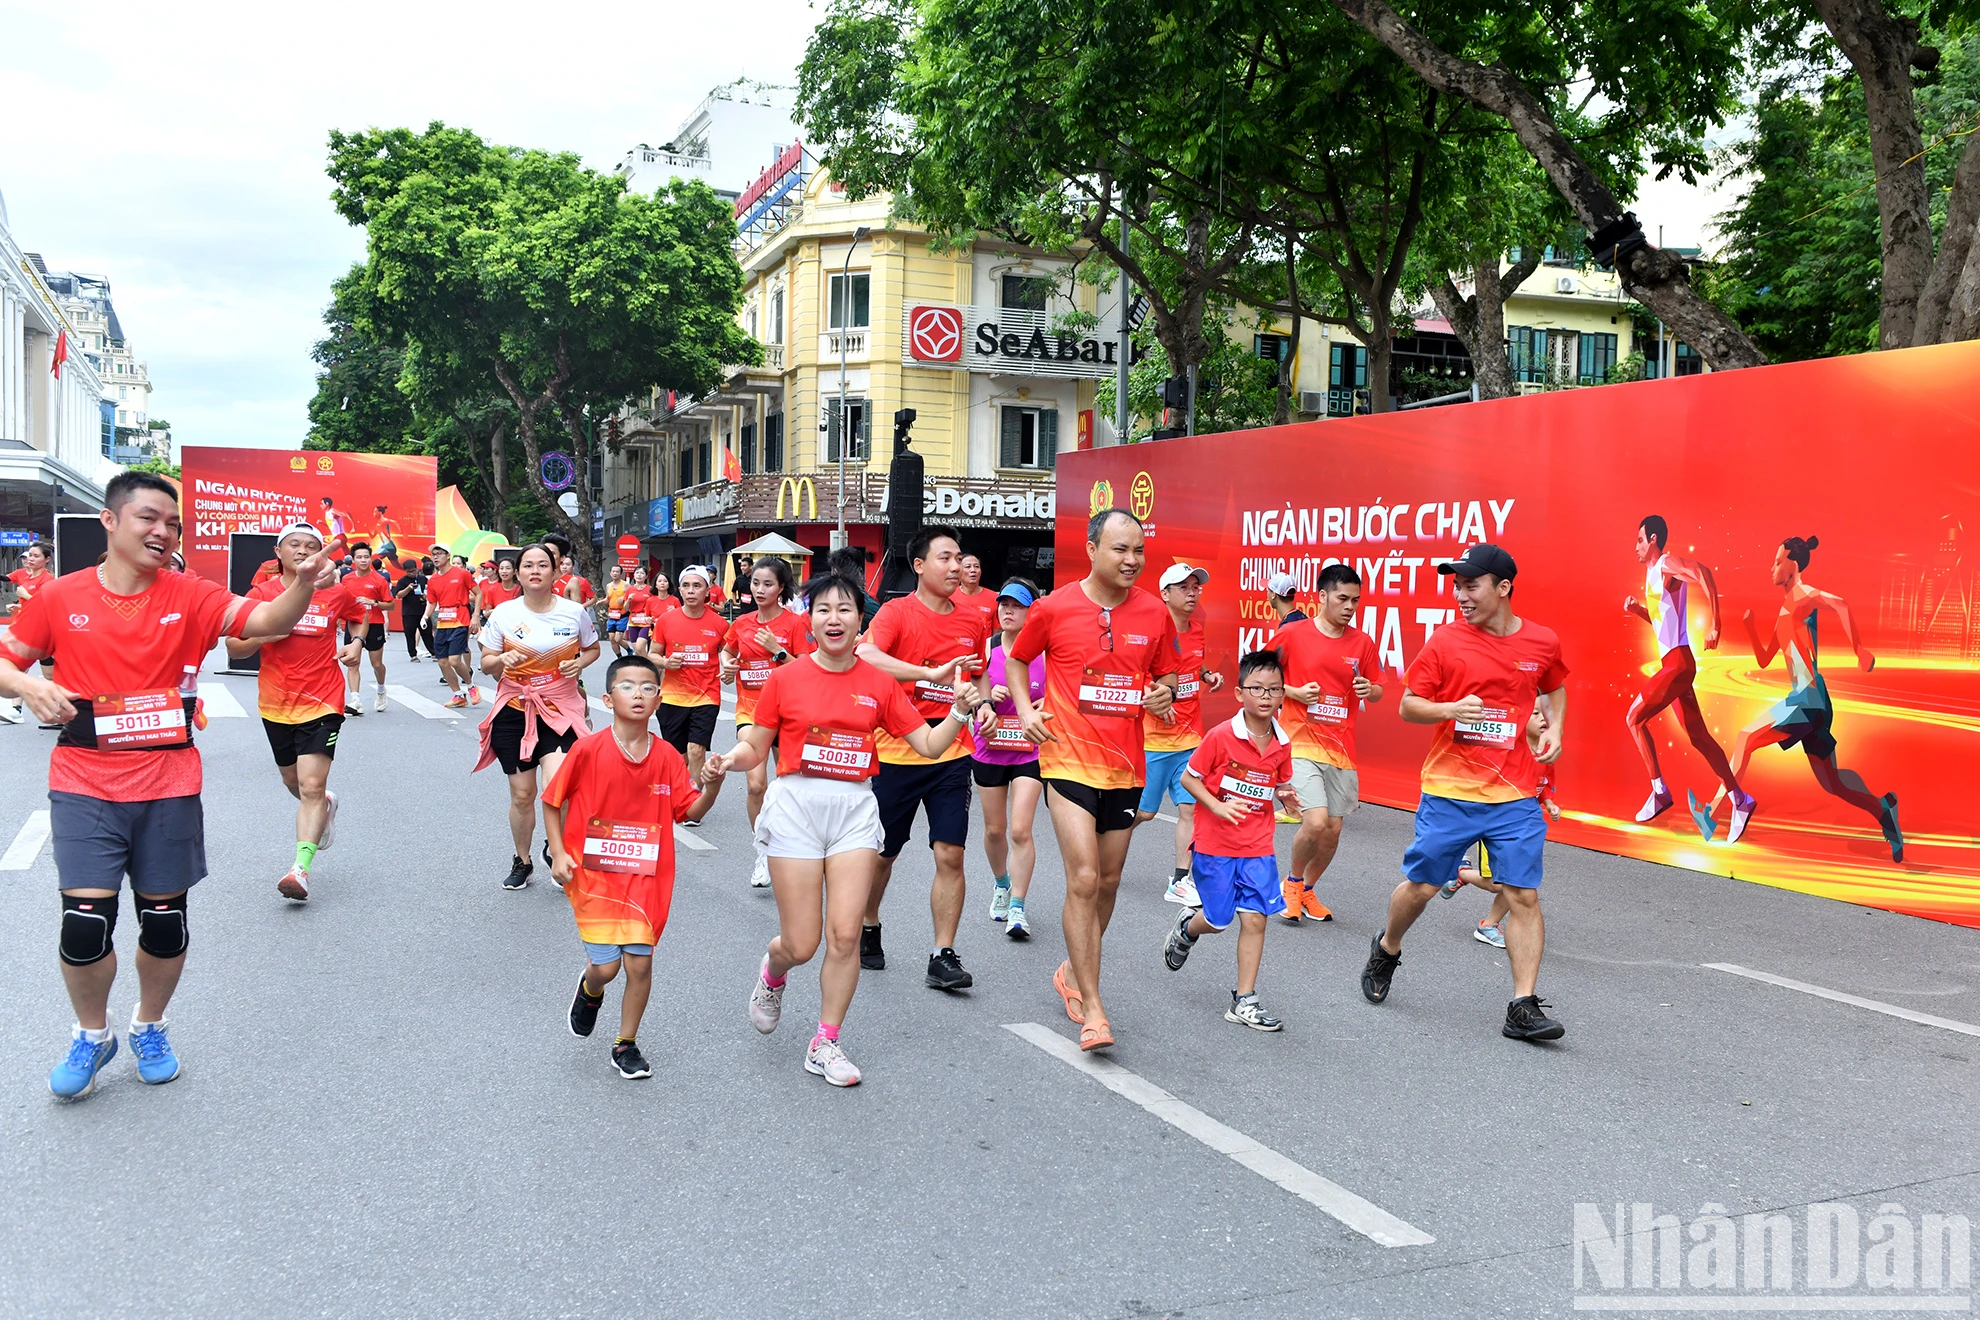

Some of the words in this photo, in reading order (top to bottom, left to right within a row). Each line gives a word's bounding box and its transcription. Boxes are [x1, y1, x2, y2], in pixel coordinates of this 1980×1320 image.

[195, 479, 248, 497] NGÀN
[195, 499, 223, 511] CHUNG
[240, 500, 284, 514] QUYẾT
[879, 486, 1055, 518] cDonald
[195, 511, 208, 520] VÌ
[209, 512, 237, 521] CỘNG
[261, 514, 284, 531] MA
[1242, 502, 1318, 547] NGÀN
[1322, 497, 1410, 545] BƯỚC
[1415, 498, 1516, 547] CHẠY
[1289, 552, 1321, 597] MỘT
[1322, 549, 1425, 596] UYẾT
[1239, 596, 1253, 619] VÌ
[747, 670, 770, 679] 50860
[1095, 689, 1128, 702] 51222
[1178, 684, 1192, 692] 0559
[1318, 706, 1341, 716] 50734
[115, 714, 161, 731] 50113
[1470, 722, 1502, 734] 10555
[108, 734, 134, 744] NGUYỄN
[159, 730, 177, 738] THẢO
[998, 730, 1022, 740] 10357
[818, 748, 858, 764] 50038
[1235, 782, 1264, 798] 10565
[600, 842, 642, 856] 50093
